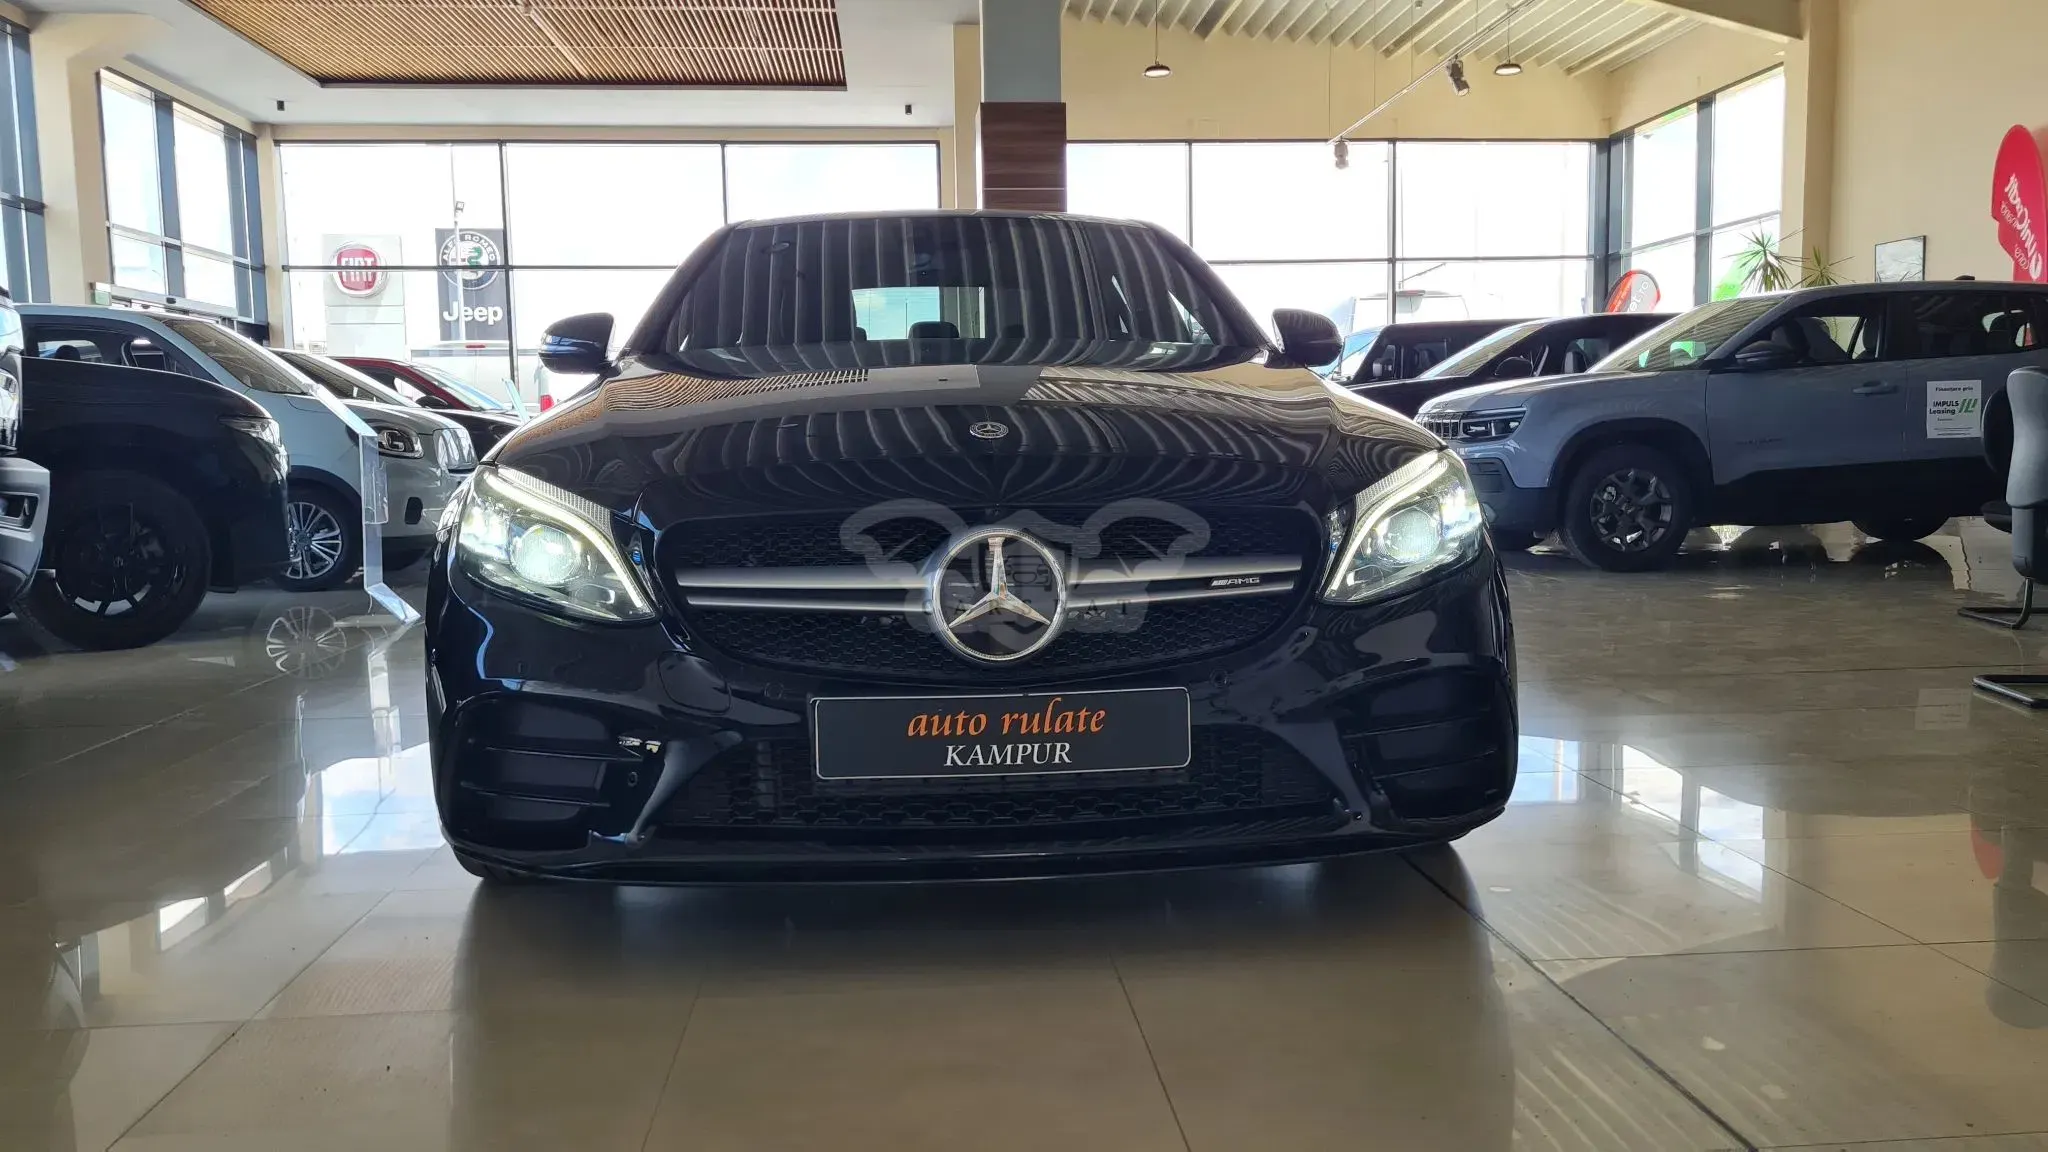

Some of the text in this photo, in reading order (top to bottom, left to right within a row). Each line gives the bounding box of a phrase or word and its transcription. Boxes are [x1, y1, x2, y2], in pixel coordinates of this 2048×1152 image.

[465, 234, 496, 261] ROMEO
[340, 257, 375, 282] FIAT
[442, 301, 503, 325] Jeep
[1226, 577, 1260, 585] AMG
[907, 697, 1106, 737] auto rulate
[943, 742, 1072, 767] KAMPUR
